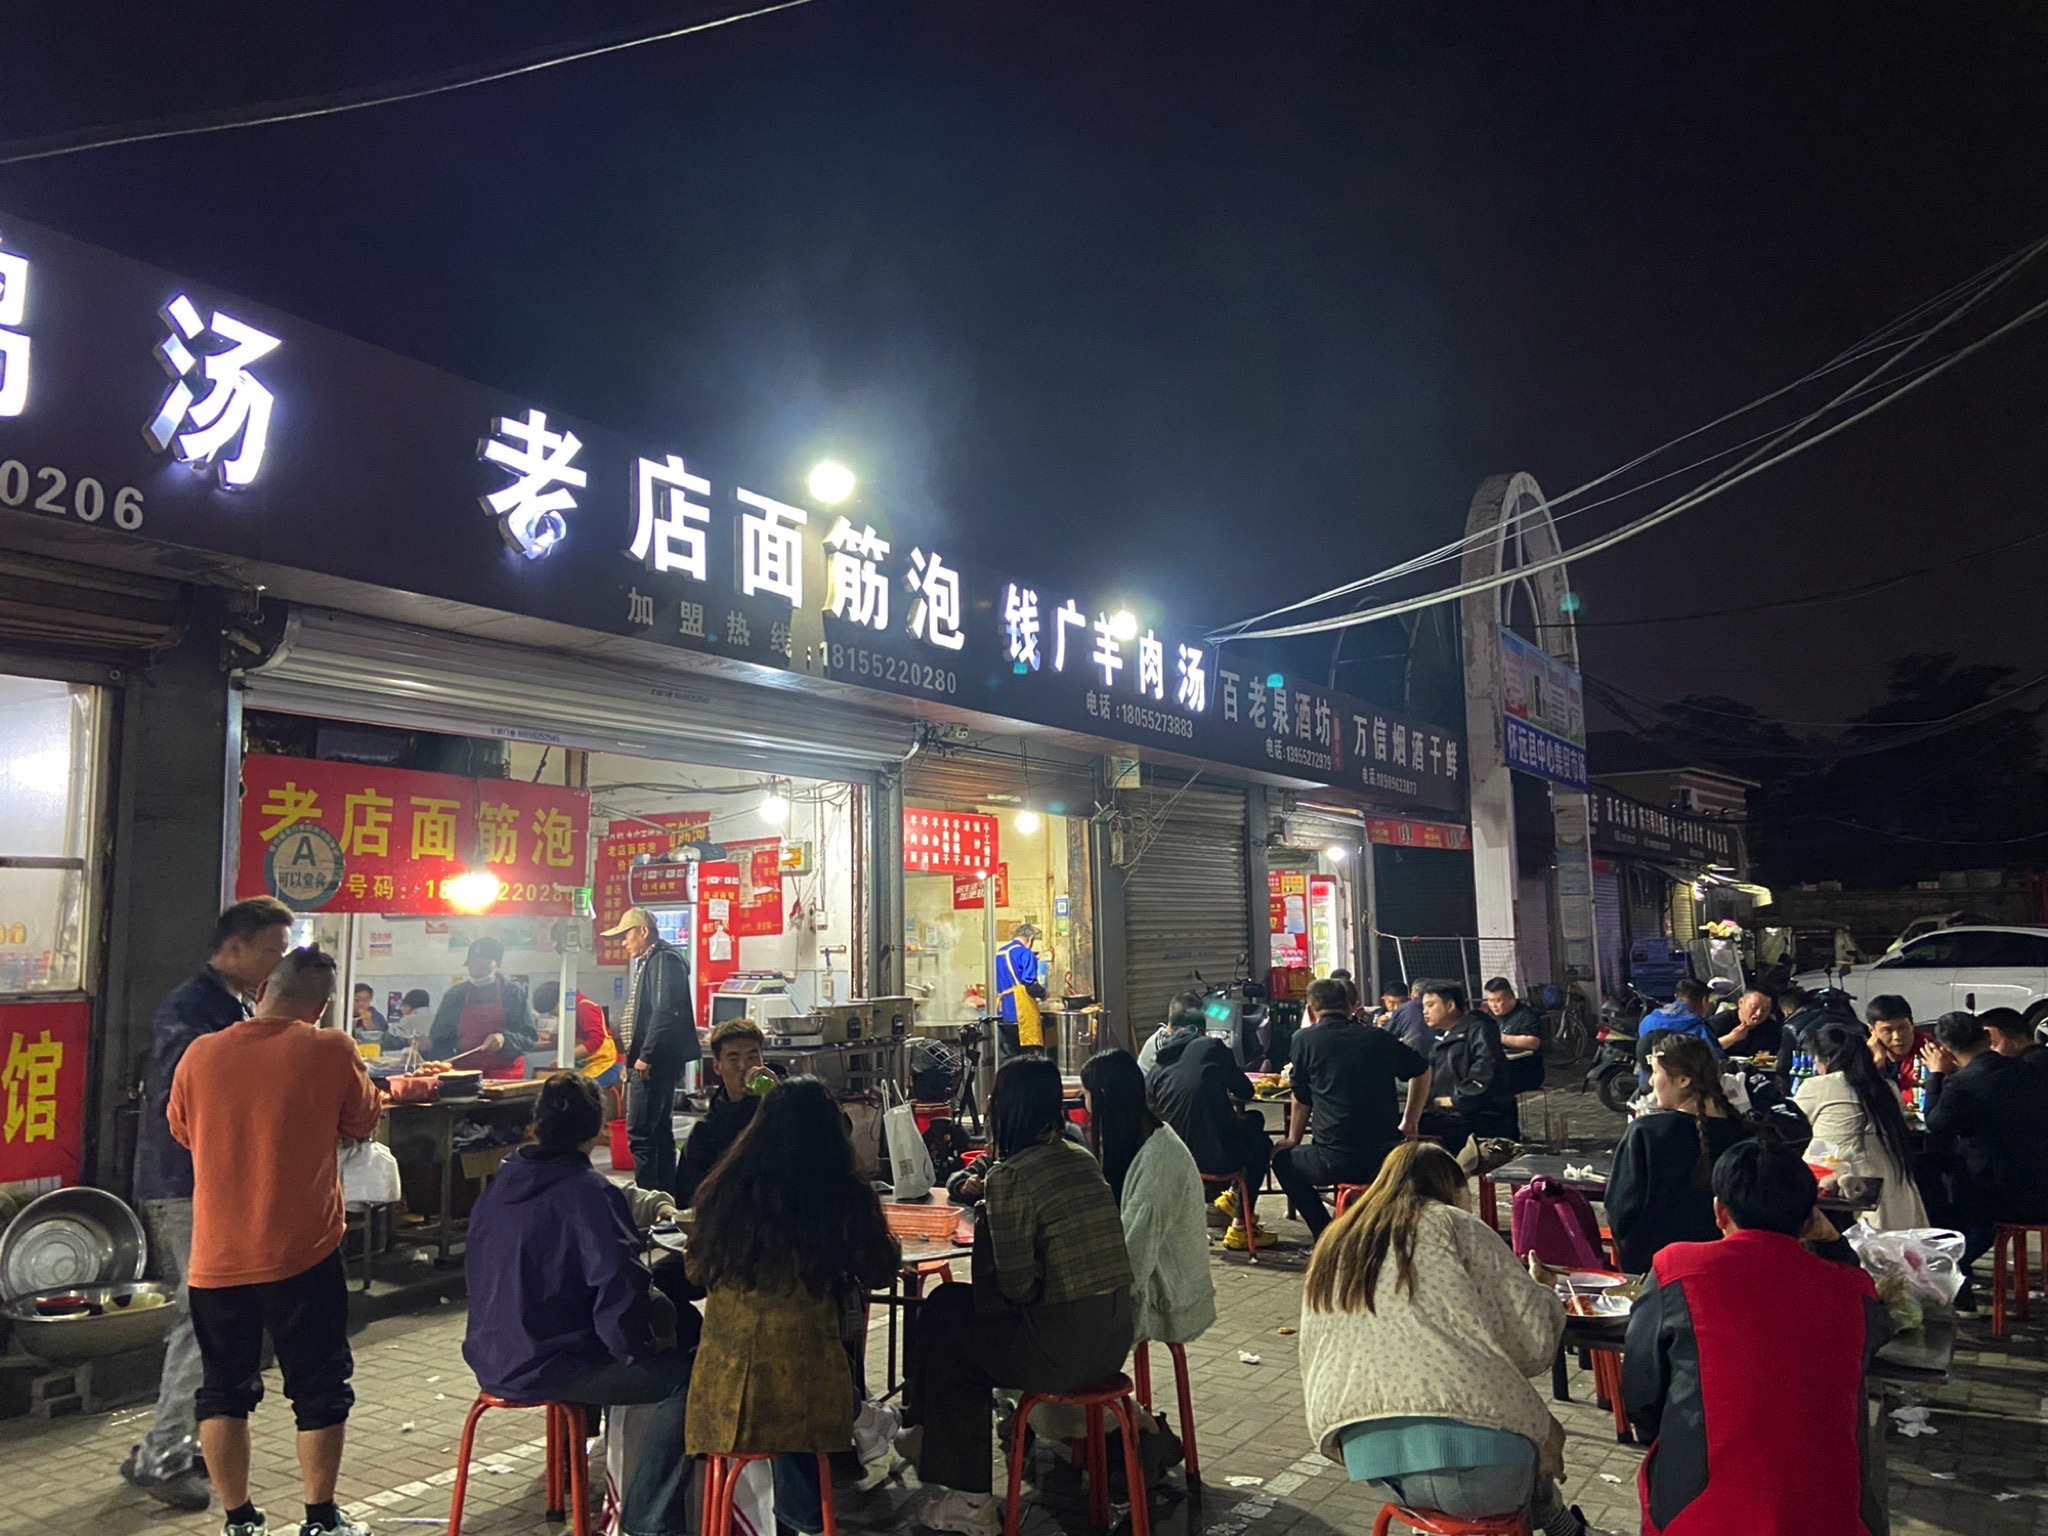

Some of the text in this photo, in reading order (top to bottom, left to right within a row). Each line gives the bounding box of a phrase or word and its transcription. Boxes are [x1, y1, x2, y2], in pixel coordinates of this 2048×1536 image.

[478, 408, 965, 651] 老店面筋泡
[1004, 582, 1206, 712] 钱广羊肉汤
[1219, 669, 1331, 747] 百老泉酒坊
[1352, 714, 1458, 780] 万信烟酒干鲜
[259, 781, 576, 867] 老店面筋泡
[291, 835, 317, 867] A
[1, 1029, 64, 1145] 馆
